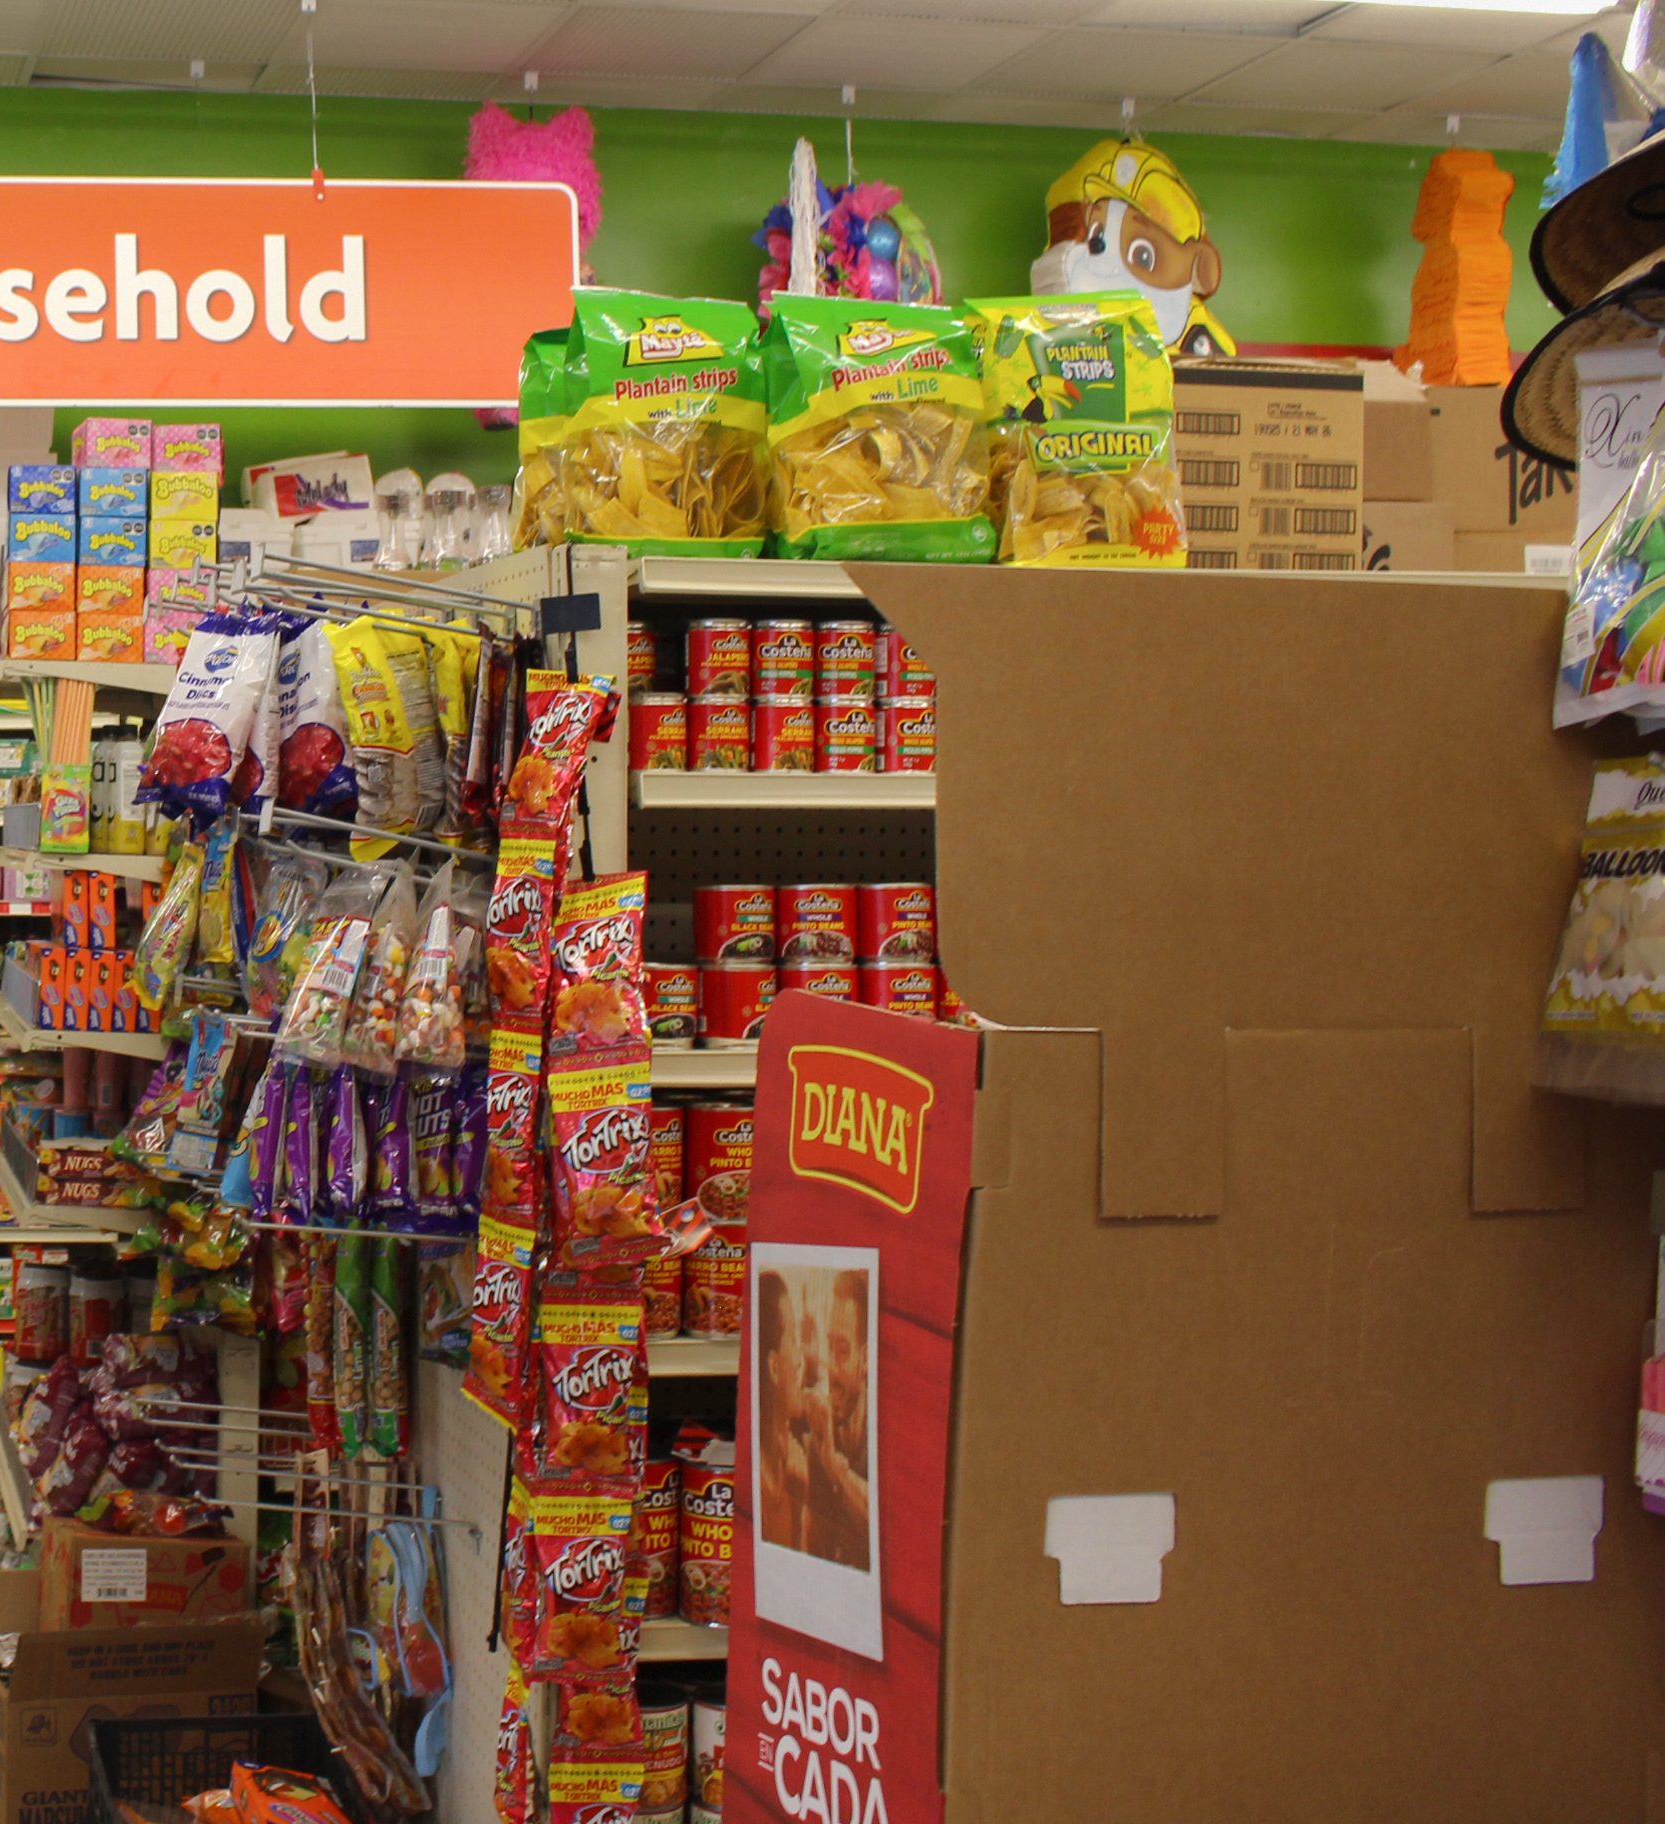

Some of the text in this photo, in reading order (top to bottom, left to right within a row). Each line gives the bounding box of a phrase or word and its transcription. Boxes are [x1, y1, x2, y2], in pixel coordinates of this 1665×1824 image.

[1045, 345, 1109, 366] PLANTAIN
[831, 361, 907, 391] Plantain
[1061, 360, 1115, 382] STRIPS
[614, 366, 738, 401] Plantain strips
[870, 376, 939, 403] with Lime
[647, 395, 719, 421] with Lime
[96, 436, 141, 453] Bubbaloo
[164, 442, 210, 459] Bubbaloo
[1036, 430, 1156, 464] ORIGINAL
[19, 481, 65, 499] Bubbaloo
[90, 485, 135, 501] Bubbaloo
[156, 478, 212, 499] Bubbaloo
[15, 520, 71, 541] Bubbaloo
[1141, 521, 1177, 538] PARTY
[90, 533, 135, 550] Bubbaloo
[13, 575, 65, 594] Bubbaloo
[83, 578, 133, 598] Bubbaloo
[14, 625, 65, 643] Bubbaloo
[82, 627, 133, 645] Bubbaloo
[783, 636, 796, 647] La
[844, 637, 857, 647] La
[851, 711, 864, 722] La
[901, 721, 936, 735] Coste
[791, 922, 845, 931] PINTO BEANS
[807, 914, 833, 922] WHOLE
[891, 921, 933, 929] PINTO BEAN
[758, 923, 775, 931] BEAN
[679, 1003, 697, 1012] BEAN
[888, 1001, 935, 1010] PINTO BEAN
[487, 1076, 532, 1114] rTrix
[551, 1090, 591, 1102] MUCHO
[568, 1099, 607, 1110] TORTRIX
[651, 1131, 682, 1143] Coste
[718, 1132, 753, 1143] Cost
[801, 1082, 908, 1176] DIANA
[651, 1145, 677, 1157] ARRO
[725, 1147, 752, 1157] WHO
[64, 1156, 104, 1171] NUGS
[709, 1158, 743, 1168] PINTO
[62, 1182, 102, 1199] NUGS
[720, 1261, 746, 1272] BEA
[473, 1267, 521, 1306] orTrix
[544, 1323, 583, 1334] MUCHO
[560, 1334, 599, 1343] TORTRIX
[711, 1483, 733, 1500] La
[684, 1494, 734, 1517] Coste
[536, 1515, 575, 1525] MUCHO
[551, 1526, 593, 1534] TORTRIX
[691, 1521, 733, 1541] WHO
[683, 1537, 715, 1557] NTO
[761, 1657, 882, 1771] SABOR
[644, 1755, 683, 1770] ENUDO
[773, 1733, 889, 1824] CADA
